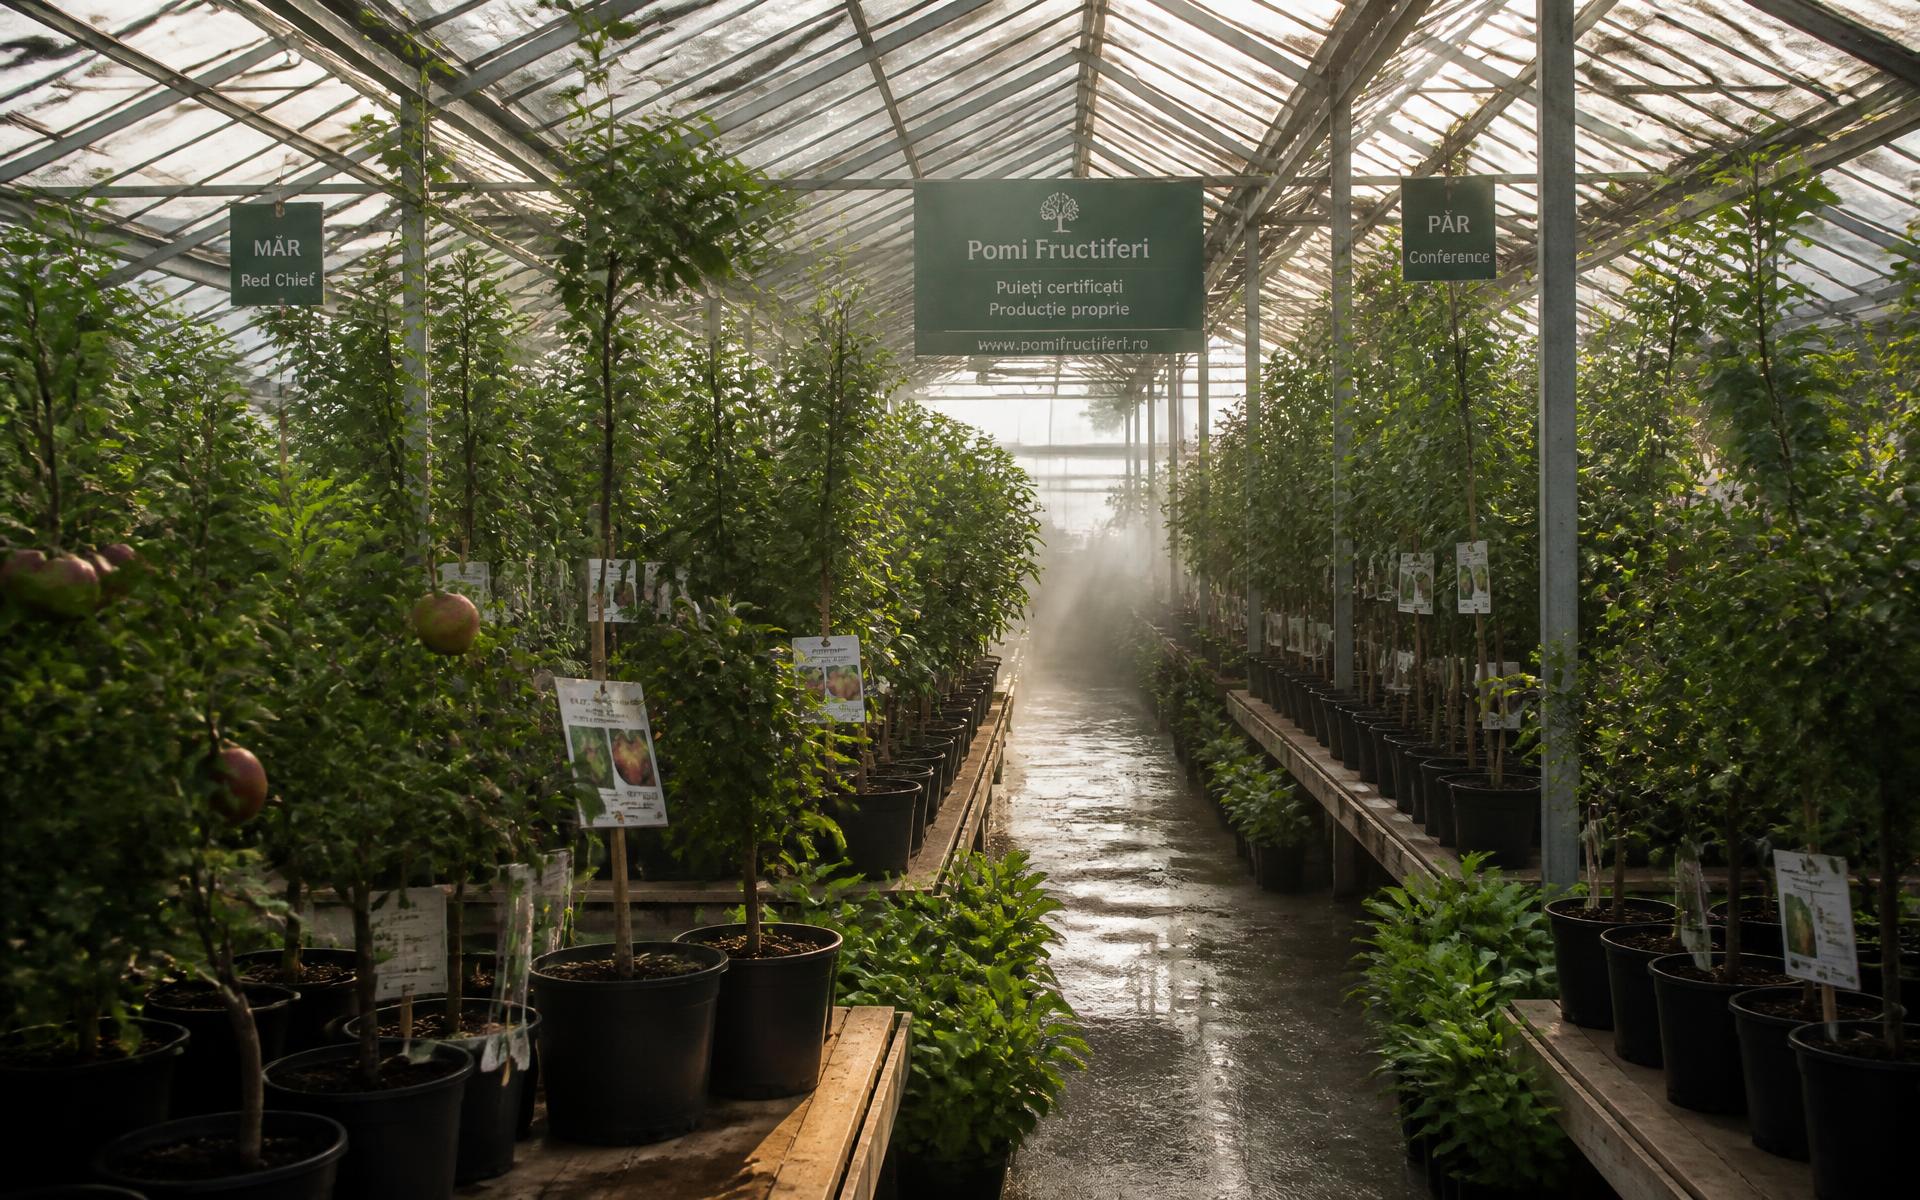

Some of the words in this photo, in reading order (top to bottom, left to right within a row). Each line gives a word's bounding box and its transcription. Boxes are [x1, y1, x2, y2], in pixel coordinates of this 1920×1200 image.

[1428, 209, 1470, 233] PĂR
[254, 234, 301, 257] MĂR
[967, 238, 1028, 261] Pomi
[1035, 237, 1150, 260] Fructiferi
[1409, 249, 1490, 264] Conference
[241, 273, 270, 287] Red
[996, 279, 1042, 299] Puieți
[989, 301, 1066, 319] Producție
[1072, 301, 1130, 319] proprie
